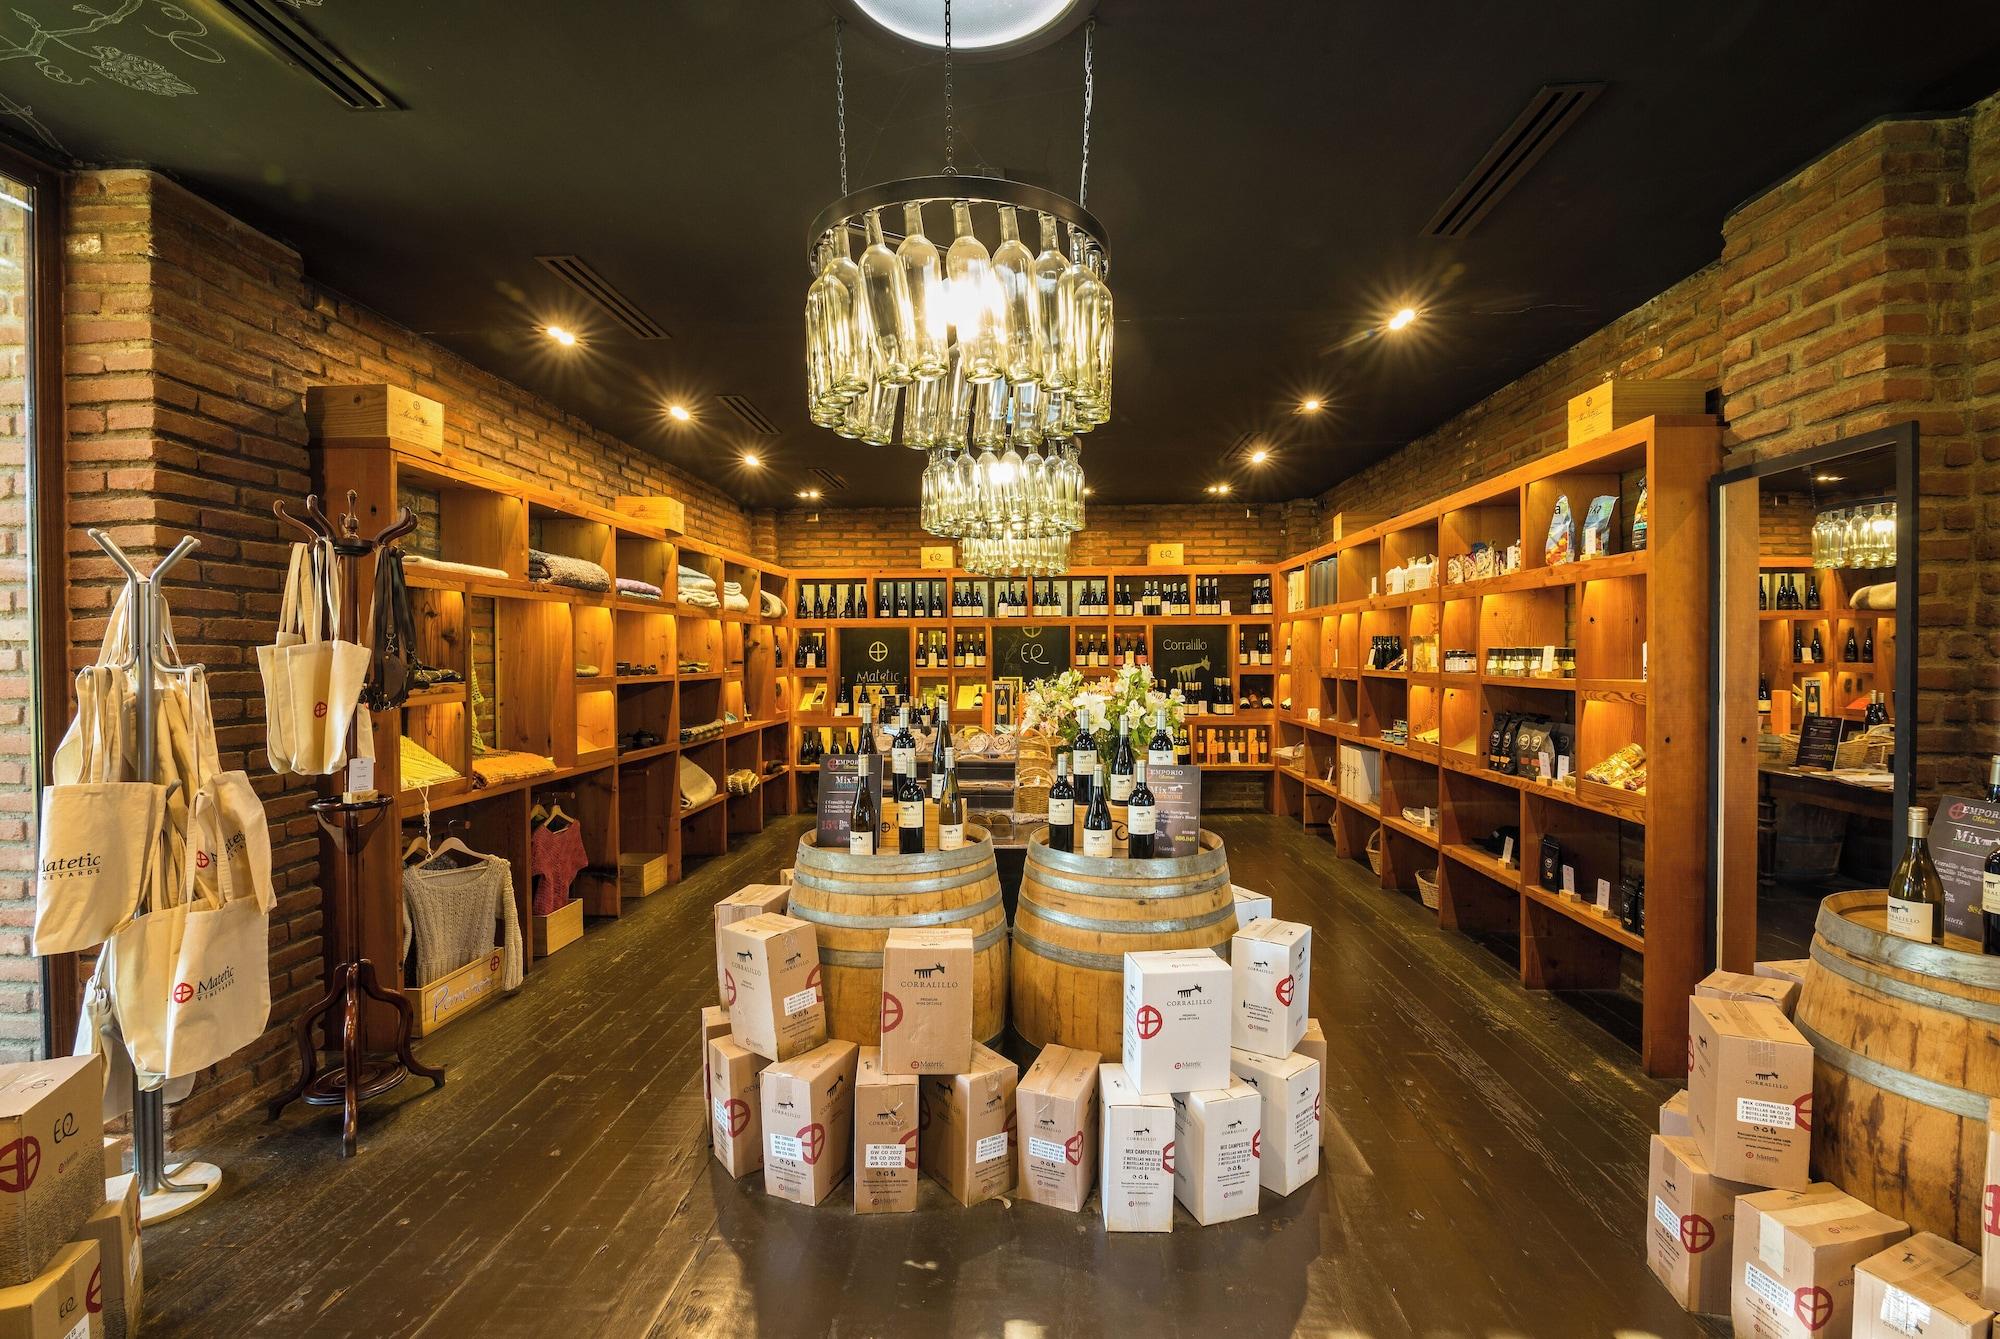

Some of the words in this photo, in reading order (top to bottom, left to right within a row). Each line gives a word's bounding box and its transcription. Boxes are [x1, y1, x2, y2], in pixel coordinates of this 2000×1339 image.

[1162, 638, 1208, 651] Corralillo
[1020, 643, 1050, 665] EQ
[856, 669, 900, 683] Matetic
[835, 775, 852, 784] Mix
[1962, 805, 2000, 819] EMPOR
[1953, 829, 1982, 846] Mix
[196, 965, 234, 994] Matetic
[900, 981, 959, 989] CORRALILLO
[1166, 999, 1213, 1007] CORRALILLO
[920, 1060, 944, 1068] Matetic
[1745, 1079, 1788, 1090] CORRALILLO
[54, 1112, 80, 1144] EQ
[60, 1297, 78, 1318] EQ
